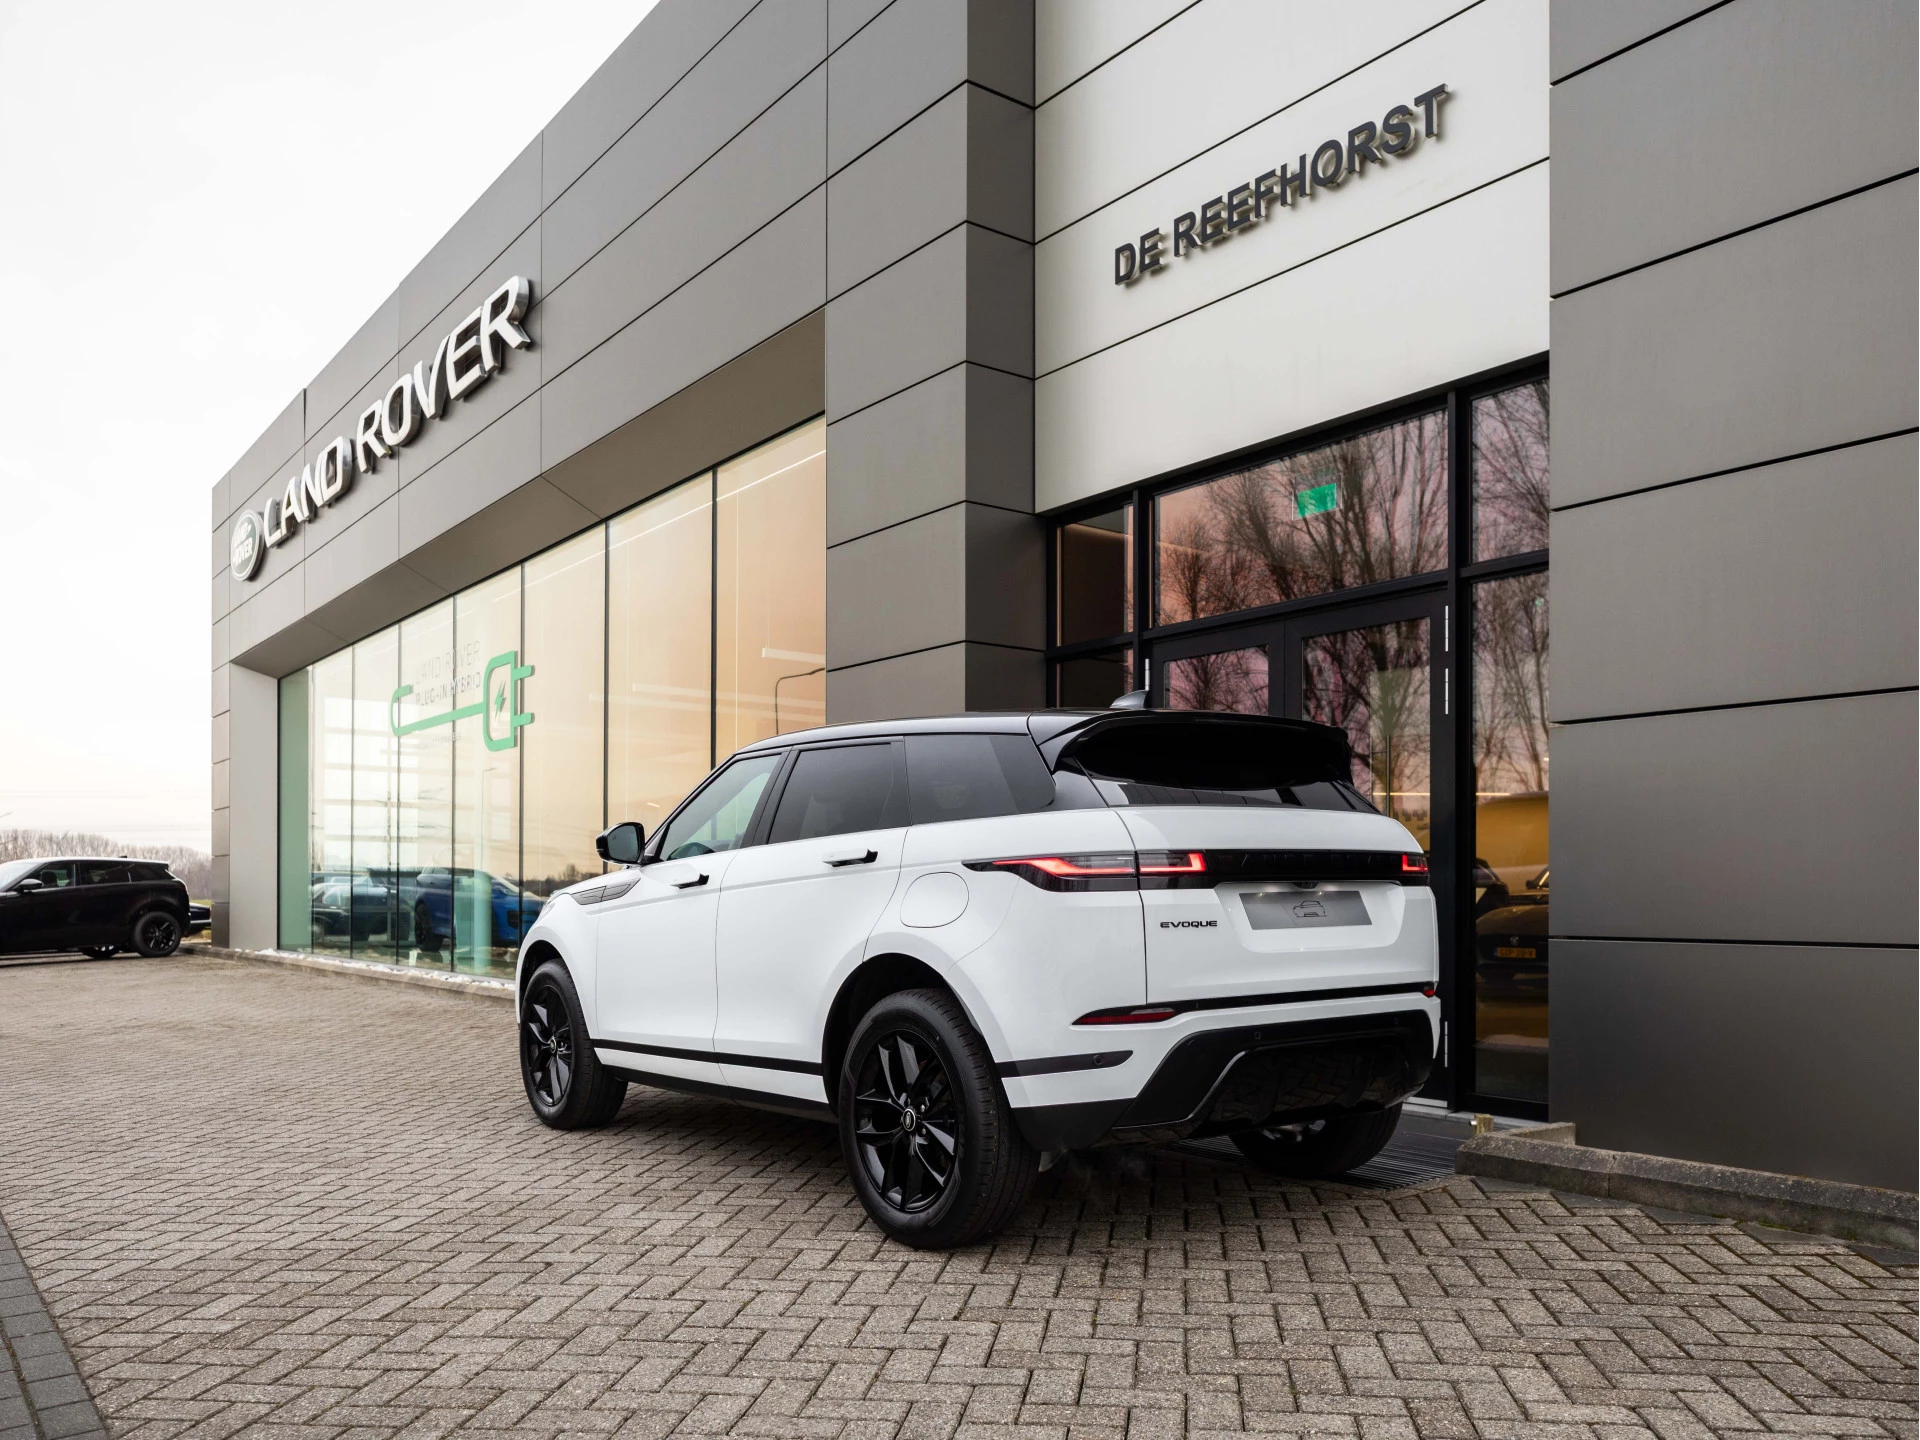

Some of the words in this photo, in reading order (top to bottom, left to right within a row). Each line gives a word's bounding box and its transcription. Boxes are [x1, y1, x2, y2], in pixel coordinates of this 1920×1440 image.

[1115, 228, 1164, 285] DE
[1174, 83, 1451, 258] REEFHORST
[264, 435, 353, 548] LAND
[356, 275, 530, 473] ROVER
[415, 683, 448, 706] PLUG-IN
[448, 671, 481, 697] HYBRID
[1160, 920, 1218, 928] EVOQUE
